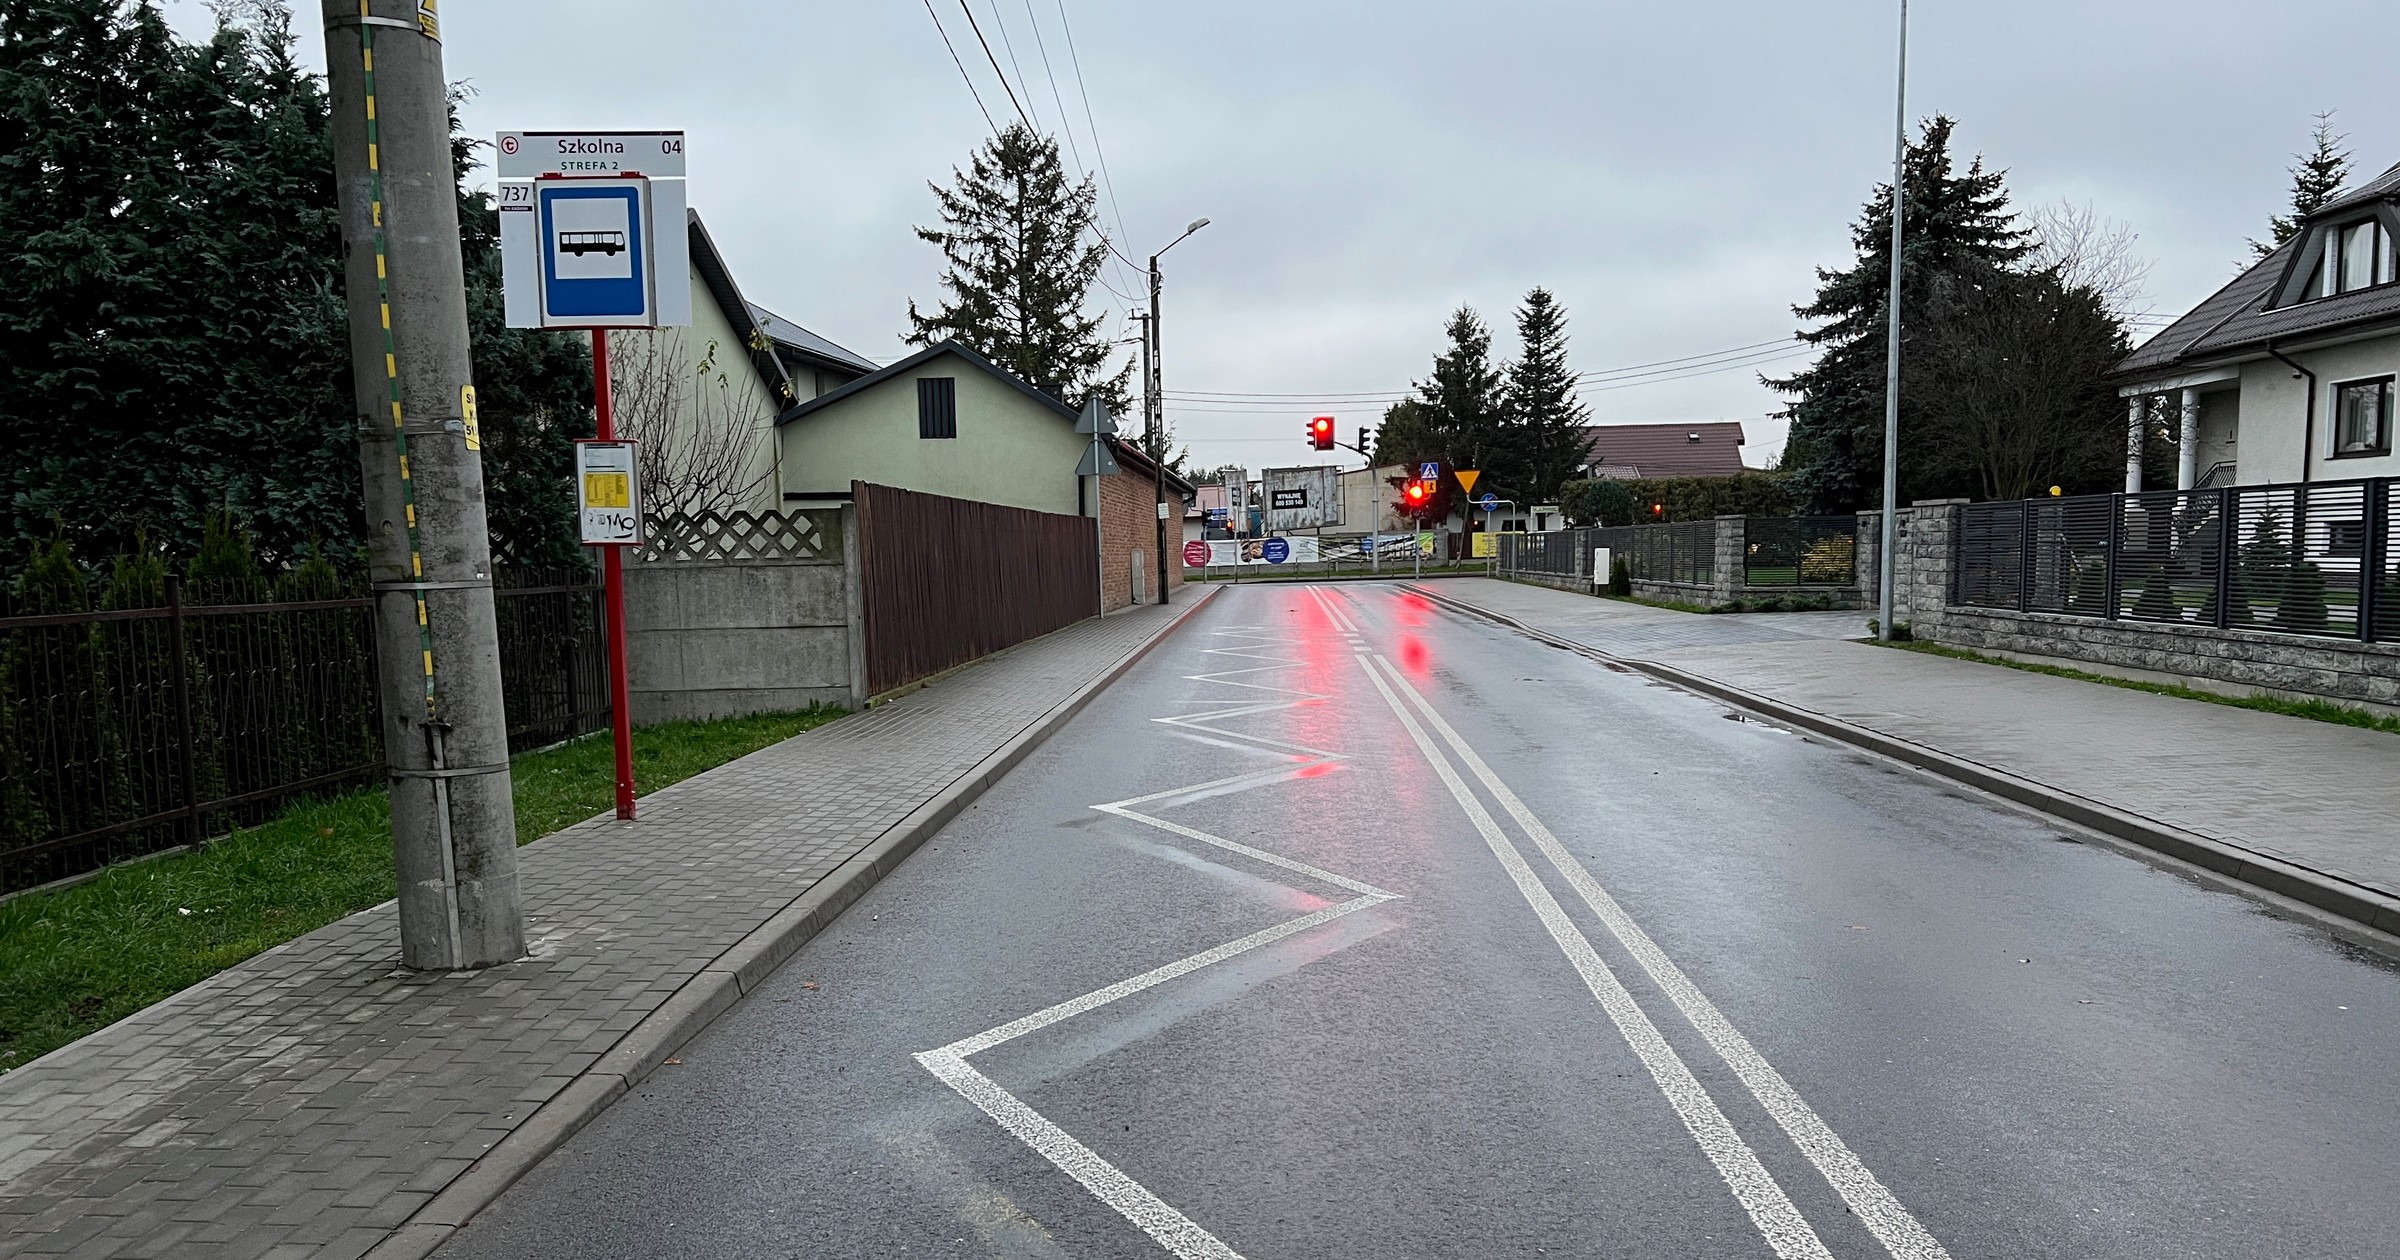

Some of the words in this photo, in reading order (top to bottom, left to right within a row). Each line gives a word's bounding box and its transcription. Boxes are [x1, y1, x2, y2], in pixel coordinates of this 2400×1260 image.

[558, 138, 624, 154] Szkolna
[661, 140, 682, 155] 04
[561, 161, 607, 170] STREFA
[612, 161, 619, 170] 2
[502, 186, 529, 201] 737
